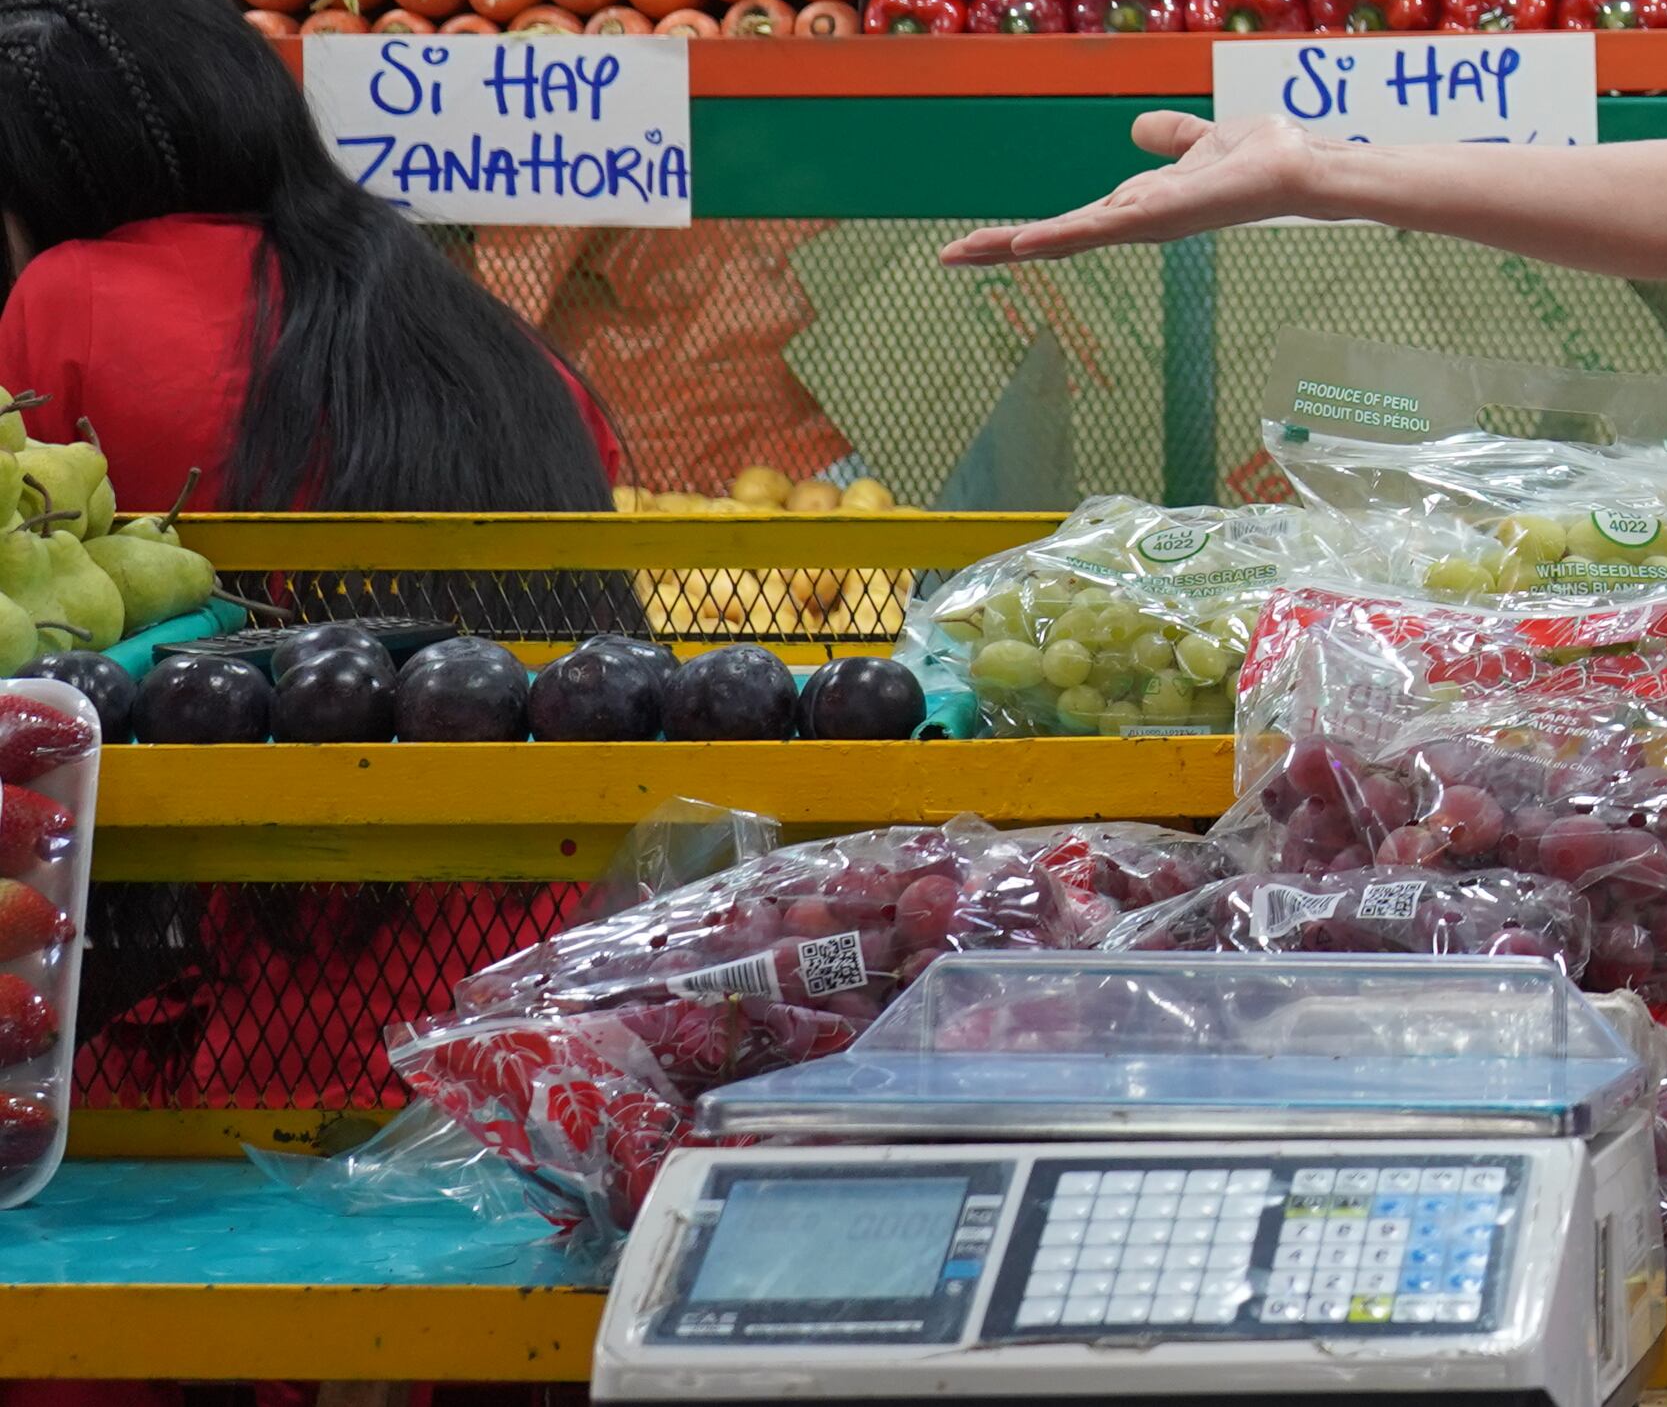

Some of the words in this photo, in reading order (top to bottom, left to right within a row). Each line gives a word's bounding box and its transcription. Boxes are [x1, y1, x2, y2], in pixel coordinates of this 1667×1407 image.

[370, 40, 449, 116] Si
[483, 44, 620, 119] HAY
[1283, 46, 1355, 120] Si
[1387, 45, 1520, 119] HAY
[1297, 380, 1361, 404] PRODUCE
[1363, 392, 1382, 407] OF
[1383, 395, 1419, 412] PERU
[1294, 399, 1352, 421] PRODUIT
[1354, 410, 1382, 426] DES
[1383, 412, 1430, 432] PÉROU
[1156, 529, 1192, 541] PLU
[1609, 520, 1648, 534] 4022
[1152, 538, 1195, 552] 4022
[1207, 564, 1278, 584] GRAPES
[1536, 562, 1587, 578] WHITE
[1589, 562, 1667, 579] SEEDLESS
[1531, 720, 1566, 737] AVEC
